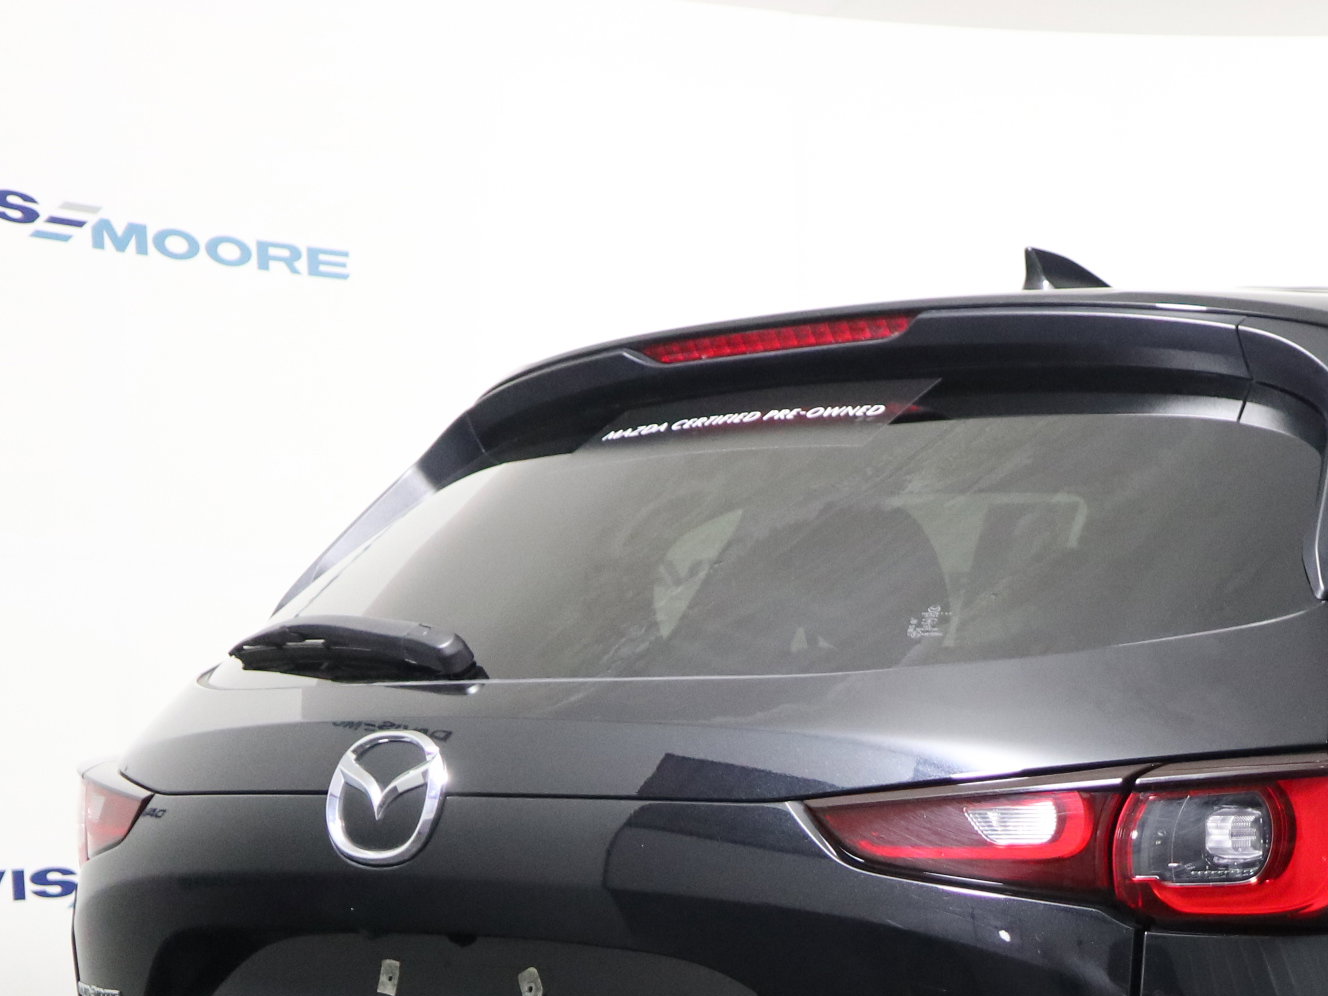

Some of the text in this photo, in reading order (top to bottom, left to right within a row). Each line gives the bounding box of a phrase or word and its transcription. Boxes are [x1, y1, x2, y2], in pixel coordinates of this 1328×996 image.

[90, 217, 350, 280] MOORE
[601, 404, 886, 442] MAZDA CERTIFIED PRE-OWNED
[0, 866, 78, 901] IS
